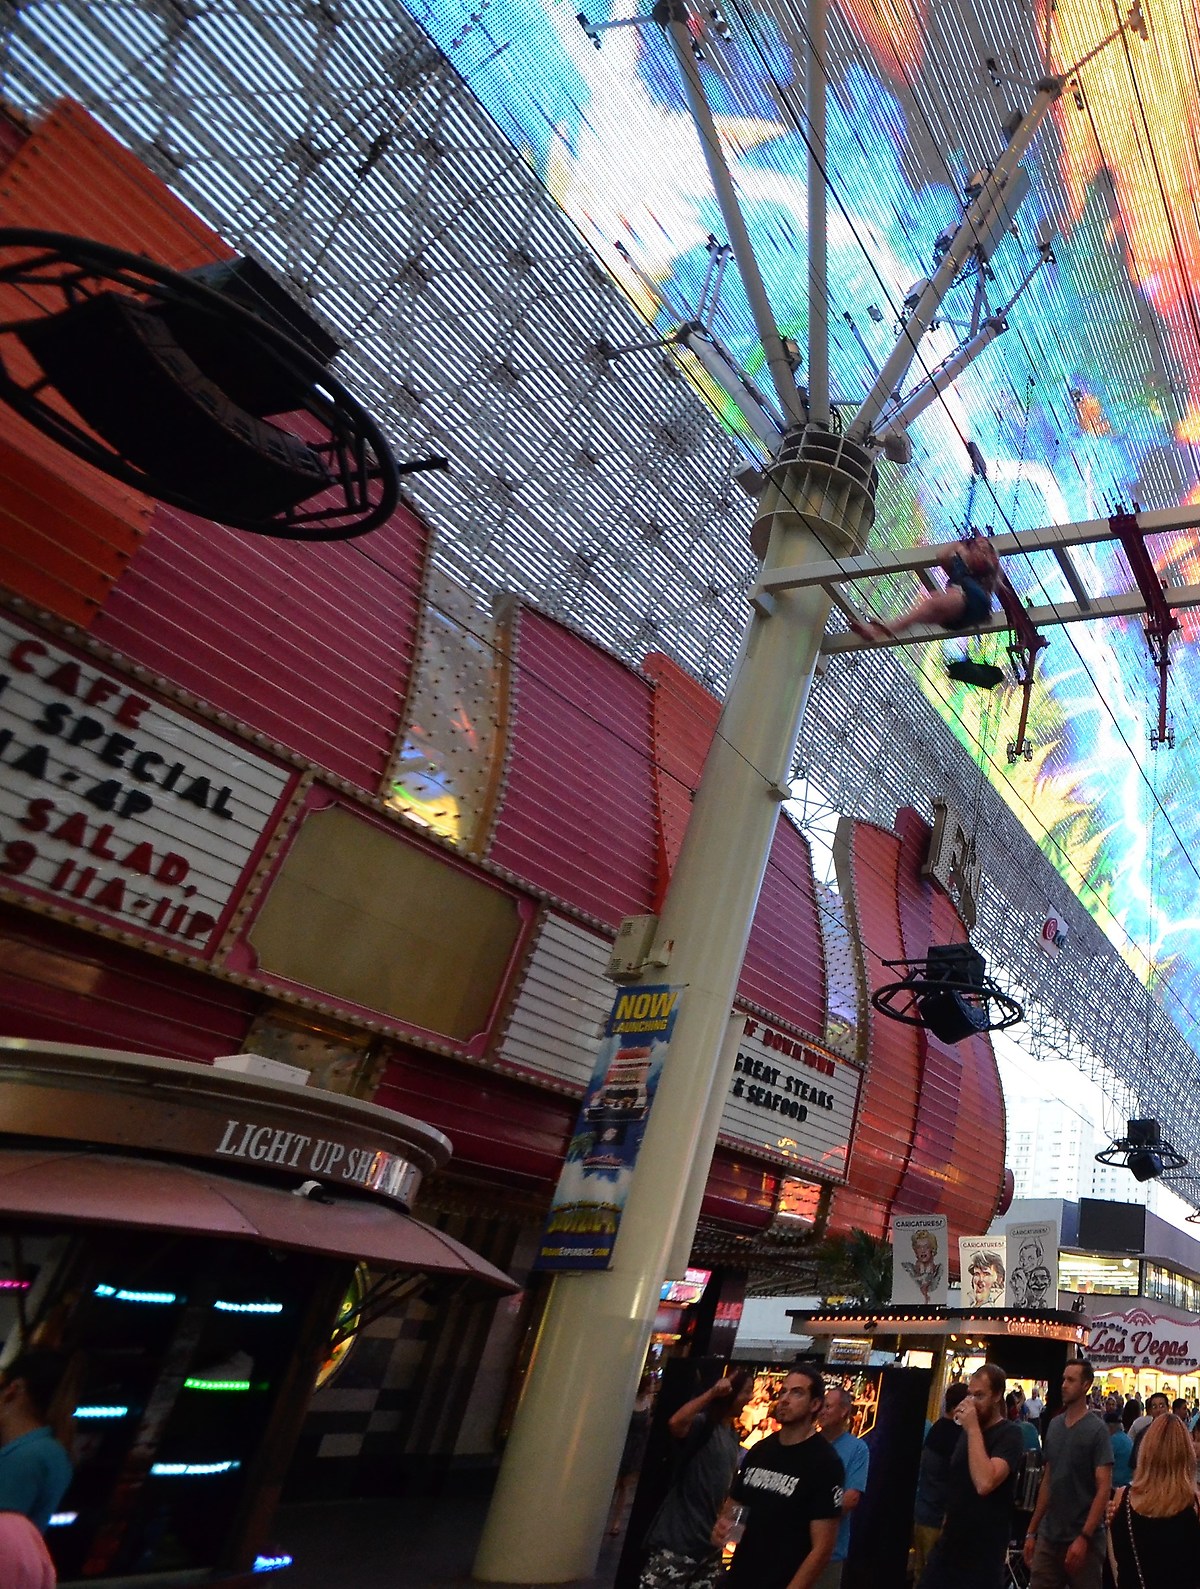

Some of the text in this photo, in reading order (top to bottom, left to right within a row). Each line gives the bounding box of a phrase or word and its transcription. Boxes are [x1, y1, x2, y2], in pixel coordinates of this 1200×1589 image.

[8, 639, 151, 730] CAFE
[32, 702, 234, 820] SPECIAL
[17, 797, 197, 898] SALAD,
[615, 991, 679, 1020] NOW
[733, 1077, 808, 1123] & SEAFOOD
[734, 1052, 834, 1111] GREAT STEAKS
[215, 1120, 311, 1168] LIGHT
[308, 1138, 345, 1174] UP
[895, 1219, 943, 1228] CARICATURES!
[962, 1241, 1005, 1249] CARICATURES!
[1084, 1329, 1126, 1355] Las
[1130, 1331, 1189, 1366] Vegas
[1165, 1358, 1199, 1367] GIFTS
